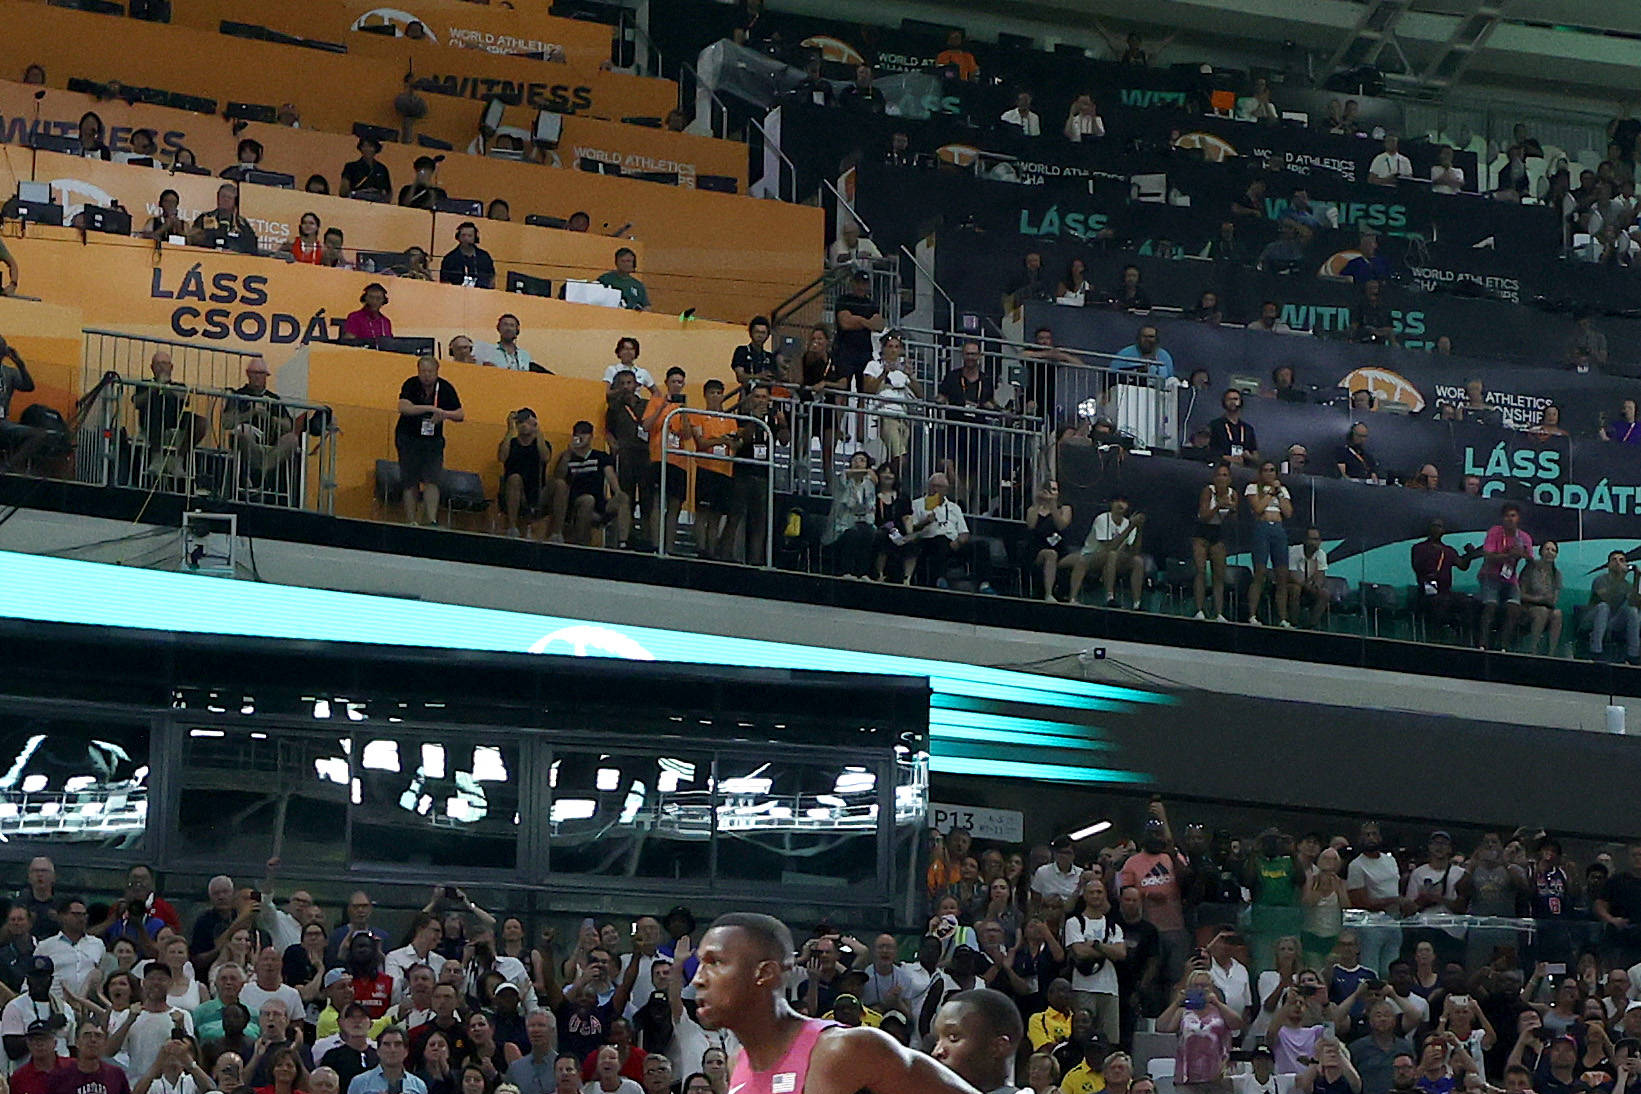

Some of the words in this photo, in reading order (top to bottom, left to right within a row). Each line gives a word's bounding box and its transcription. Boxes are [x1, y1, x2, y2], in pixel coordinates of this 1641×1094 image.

[573, 145, 621, 163] WORLD
[626, 154, 696, 174] ATHLETICS
[151, 262, 268, 305] LÁSS
[1464, 440, 1561, 479] LÁSS
[935, 810, 974, 831] P13
